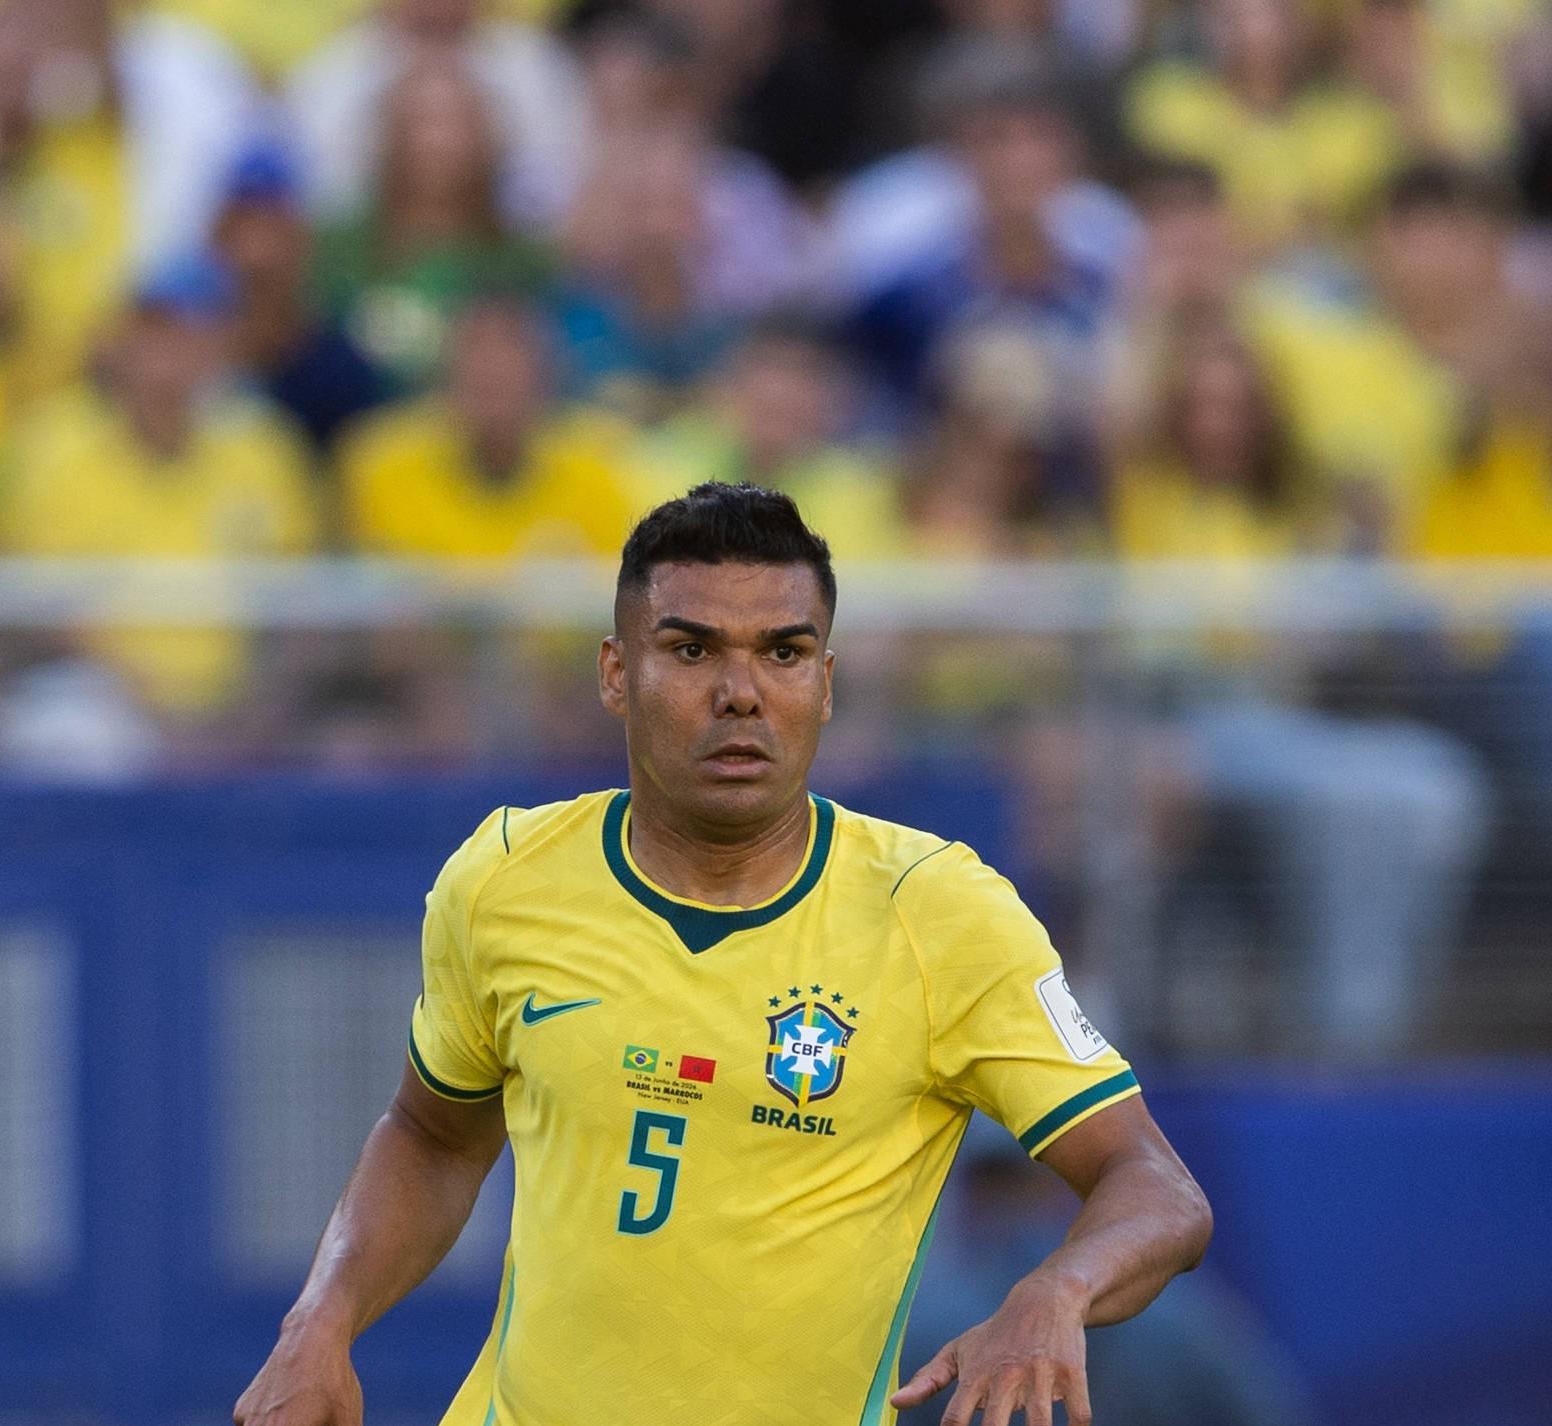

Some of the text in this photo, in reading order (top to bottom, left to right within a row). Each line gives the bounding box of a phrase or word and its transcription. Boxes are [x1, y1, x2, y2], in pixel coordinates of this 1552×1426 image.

[791, 1042, 824, 1057] CBF
[626, 1080, 650, 1091] BRASIL
[663, 1087, 703, 1101] MARROCOS
[751, 1104, 837, 1136] BRASIL
[616, 1108, 689, 1237] 5
